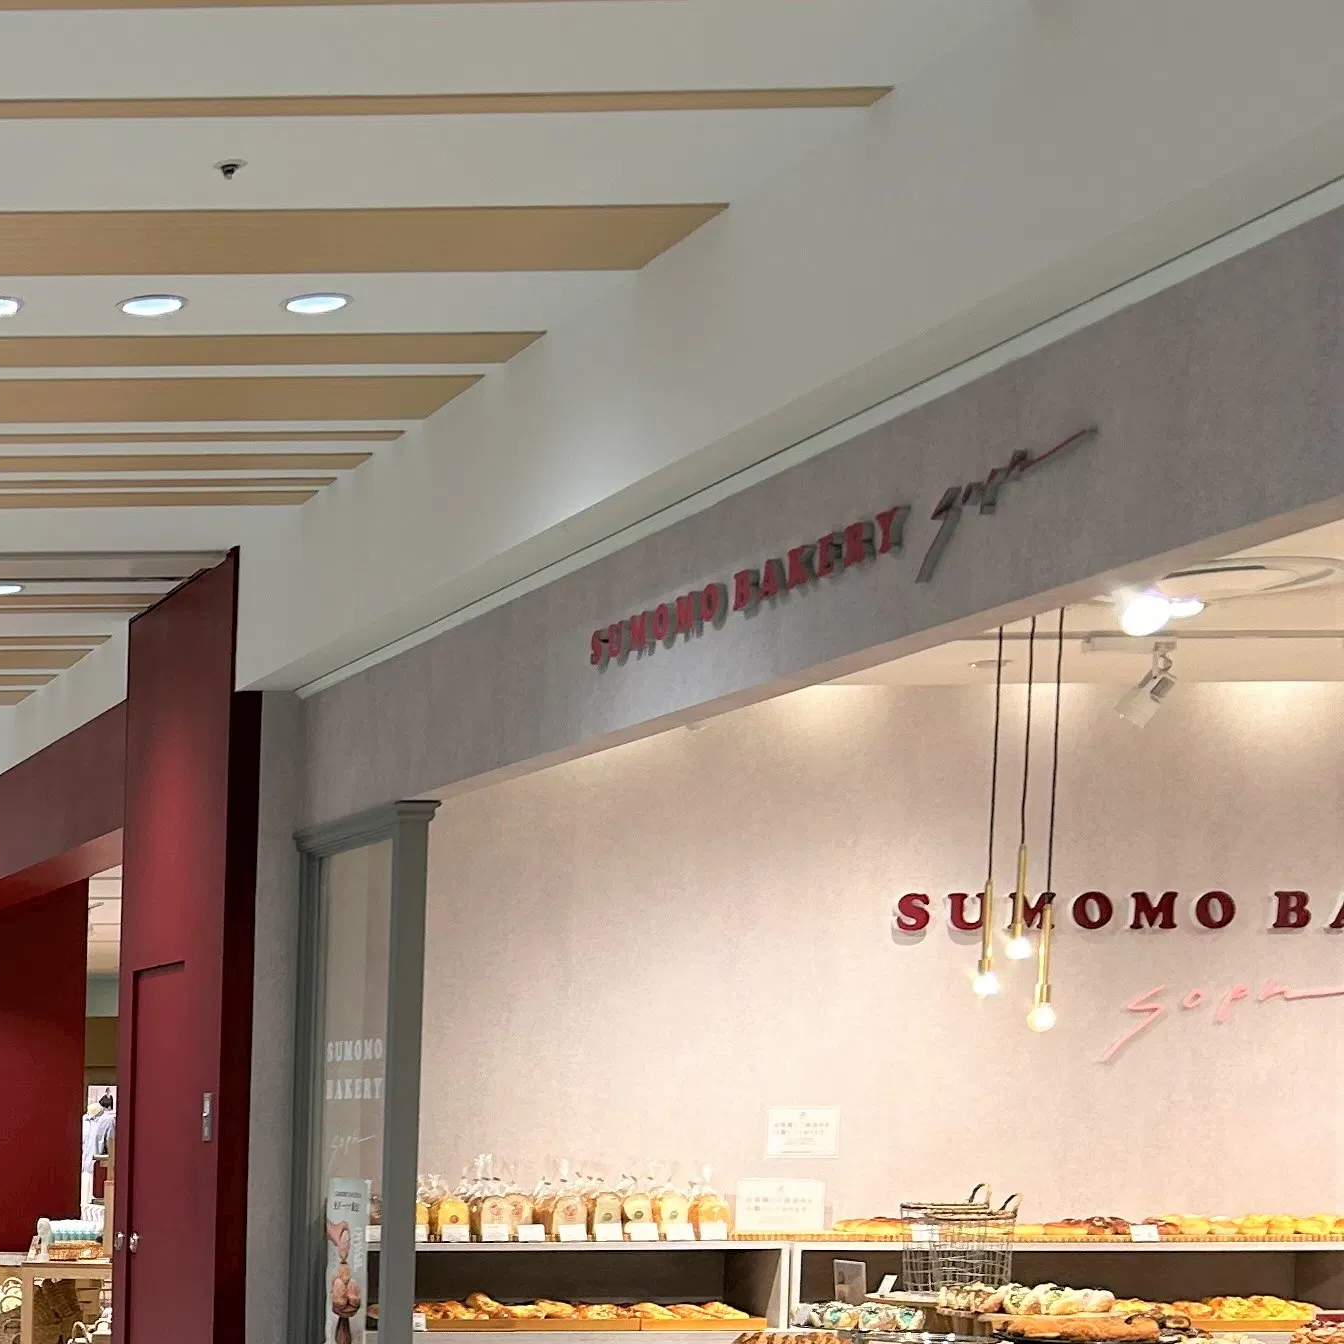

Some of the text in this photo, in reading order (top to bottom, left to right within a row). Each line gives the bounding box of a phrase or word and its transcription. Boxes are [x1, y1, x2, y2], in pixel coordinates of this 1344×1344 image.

[590, 583, 718, 667] SUMOMO
[733, 506, 902, 612] BAKERY
[896, 890, 1236, 931] SUMOMO
[326, 1038, 384, 1063] SUMOMO
[325, 1077, 385, 1100] BAKERY
